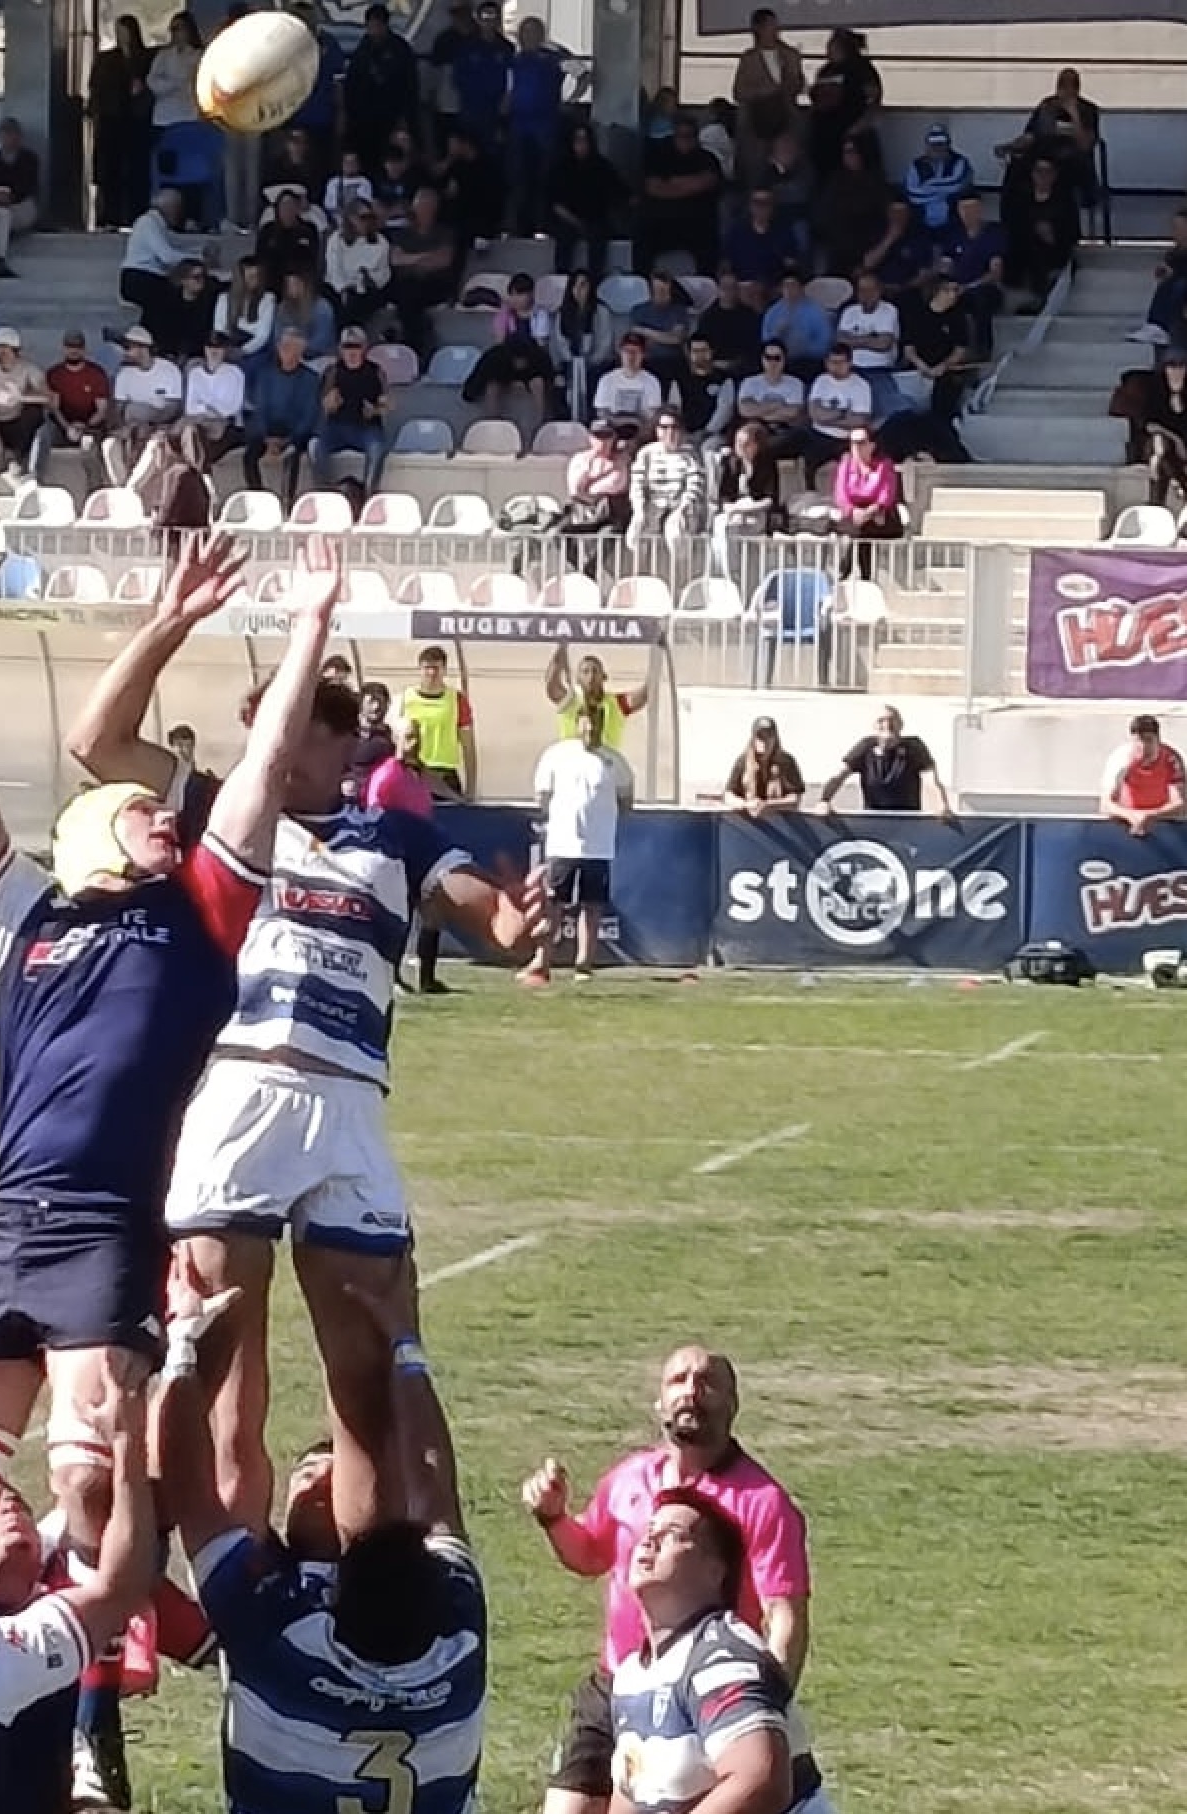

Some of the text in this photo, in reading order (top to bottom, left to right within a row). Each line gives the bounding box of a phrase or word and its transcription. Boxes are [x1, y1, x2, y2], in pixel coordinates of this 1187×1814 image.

[439, 616, 642, 638] RUGBY LA VILA
[1057, 592, 1187, 672] HUE
[1080, 870, 1187, 933] HUES
[336, 1730, 414, 1814] 3
